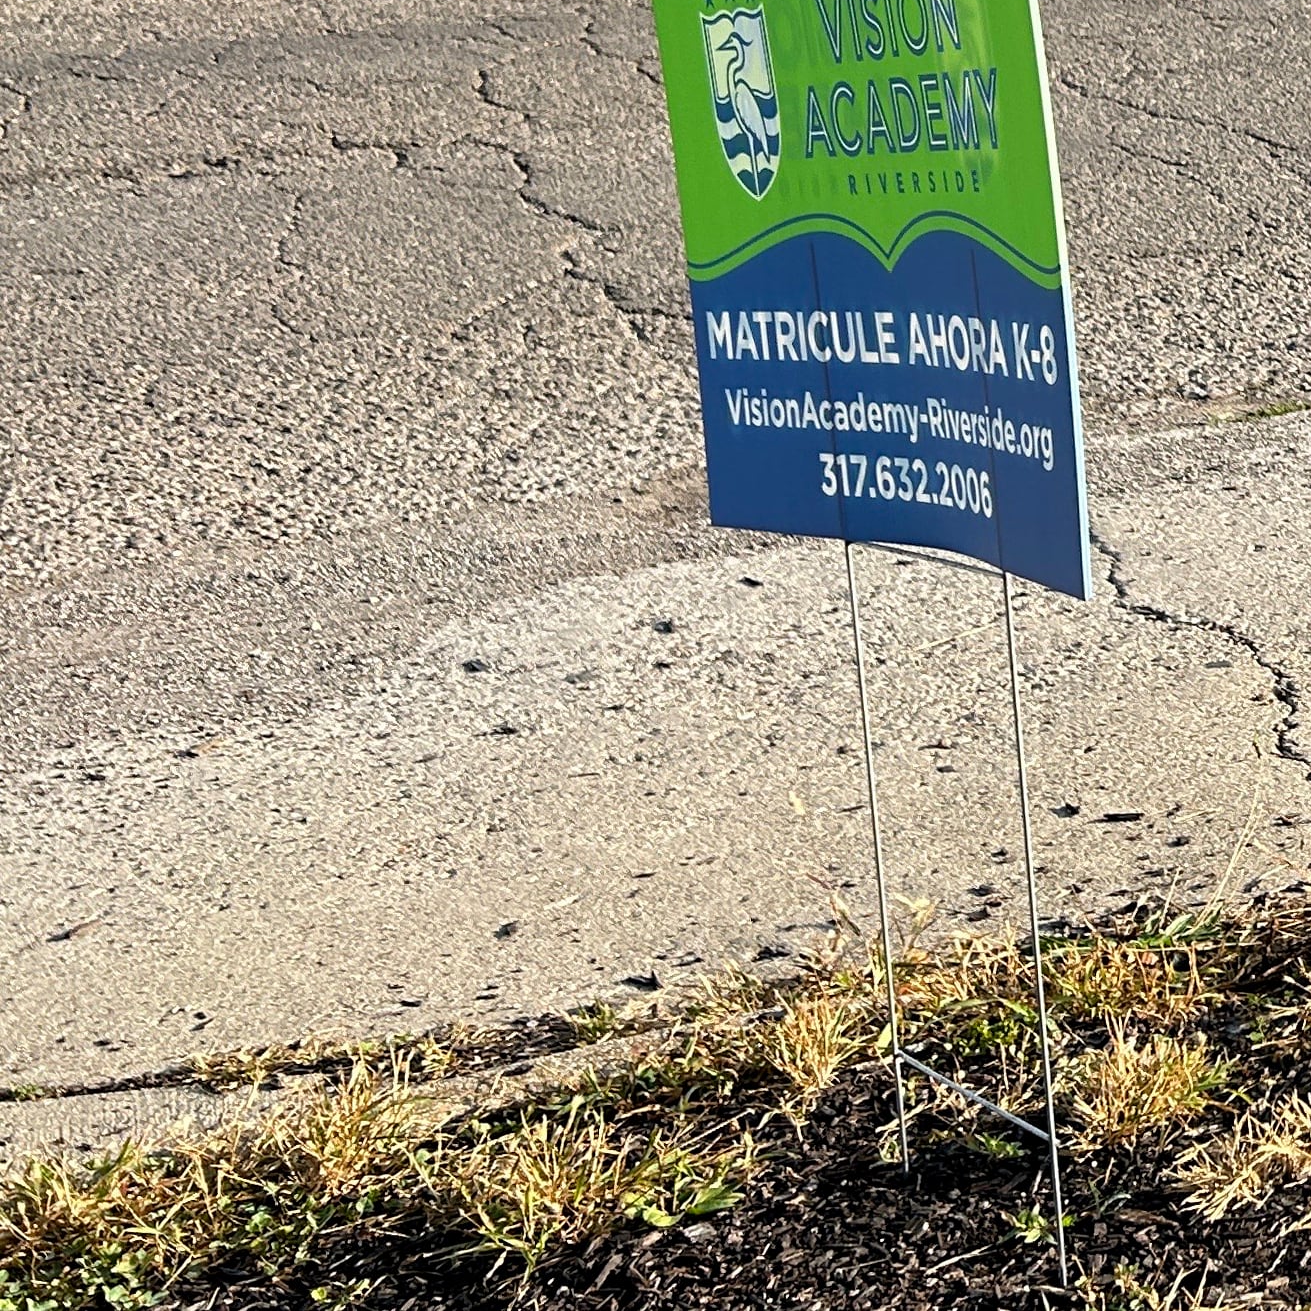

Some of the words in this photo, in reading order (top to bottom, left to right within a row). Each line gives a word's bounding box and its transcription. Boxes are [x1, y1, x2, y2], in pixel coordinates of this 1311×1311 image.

[805, 68, 1000, 158] ACADEMY
[848, 169, 981, 196] RIVERSIDE
[706, 311, 900, 365] MATRICULE
[907, 315, 1008, 375] AHORA
[1012, 327, 1057, 385] K-8
[726, 388, 1055, 471] VisionAcademy-Riverside.org
[818, 452, 993, 518] 317.632.2006
